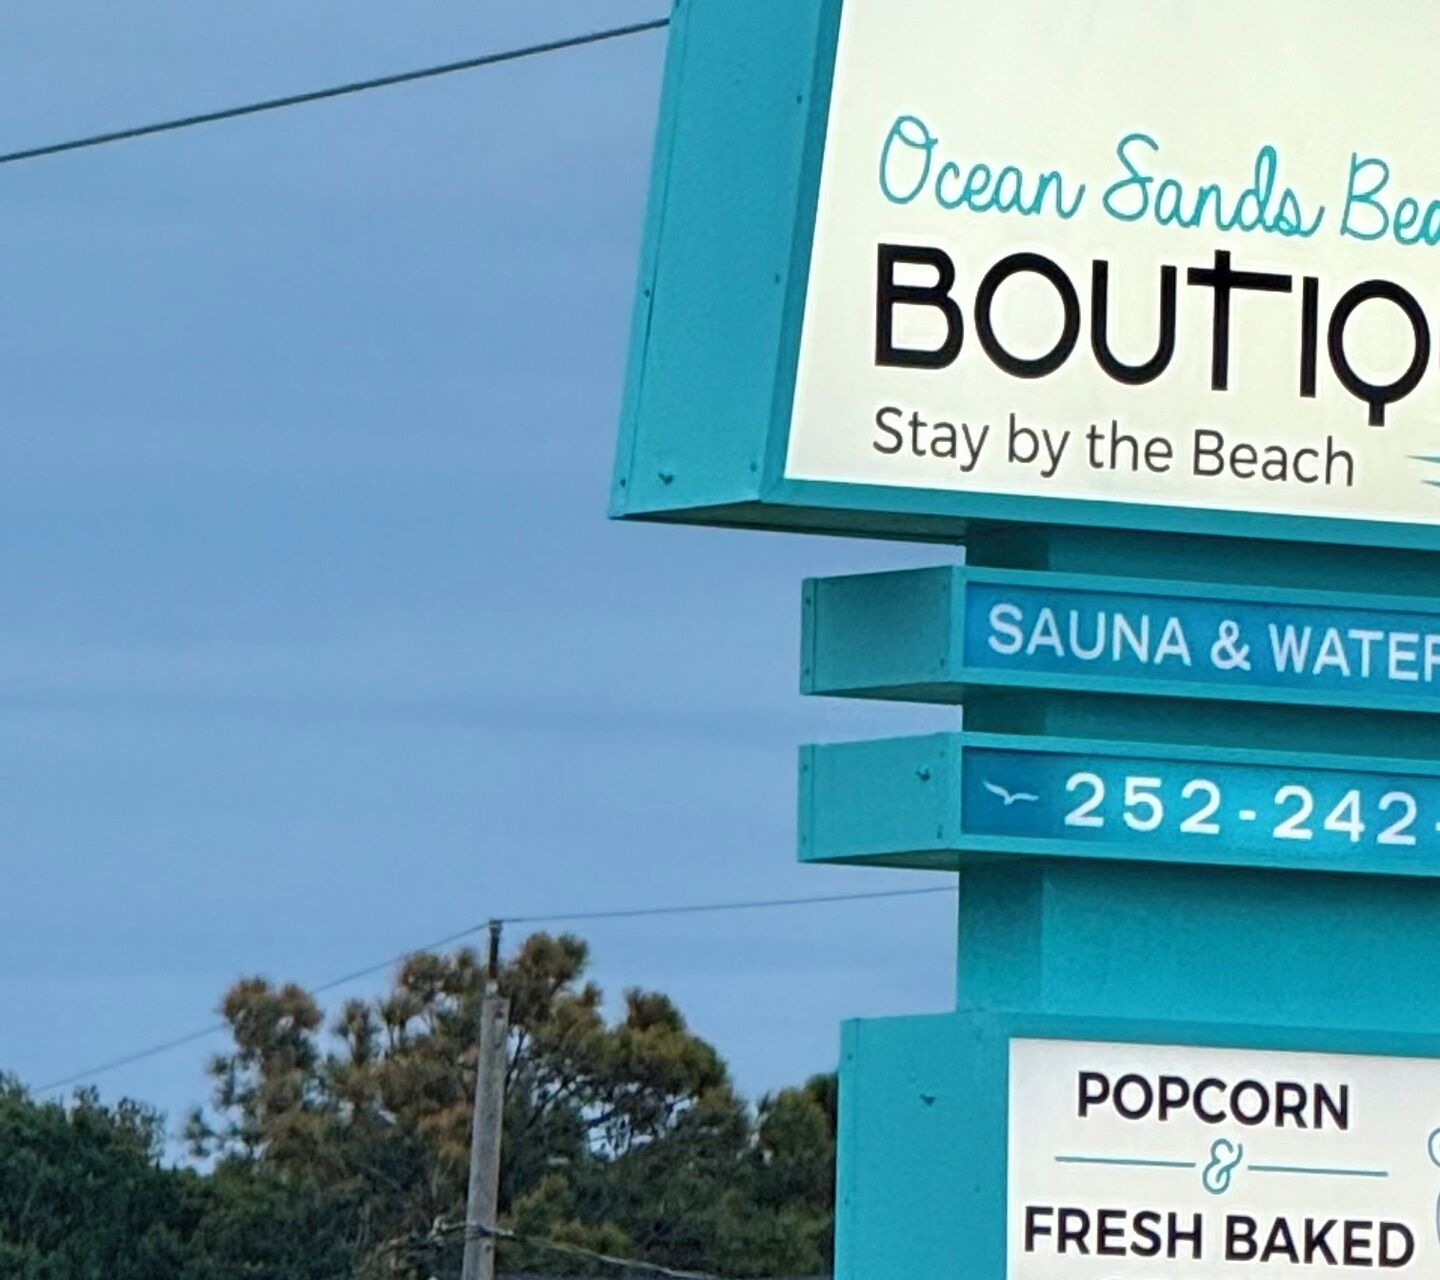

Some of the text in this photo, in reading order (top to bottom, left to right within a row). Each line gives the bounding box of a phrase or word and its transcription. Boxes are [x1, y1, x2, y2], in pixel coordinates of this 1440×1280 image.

[877, 115, 1085, 220] Ocean
[1103, 133, 1324, 238] Sands
[871, 405, 1356, 487] Stay by the Beach
[986, 603, 1192, 668] SAUNA
[1210, 619, 1251, 673] &
[1076, 1070, 1350, 1131] POPCORN
[1201, 1137, 1244, 1195] &
[1023, 1205, 1416, 1269] FRESH BAKED
